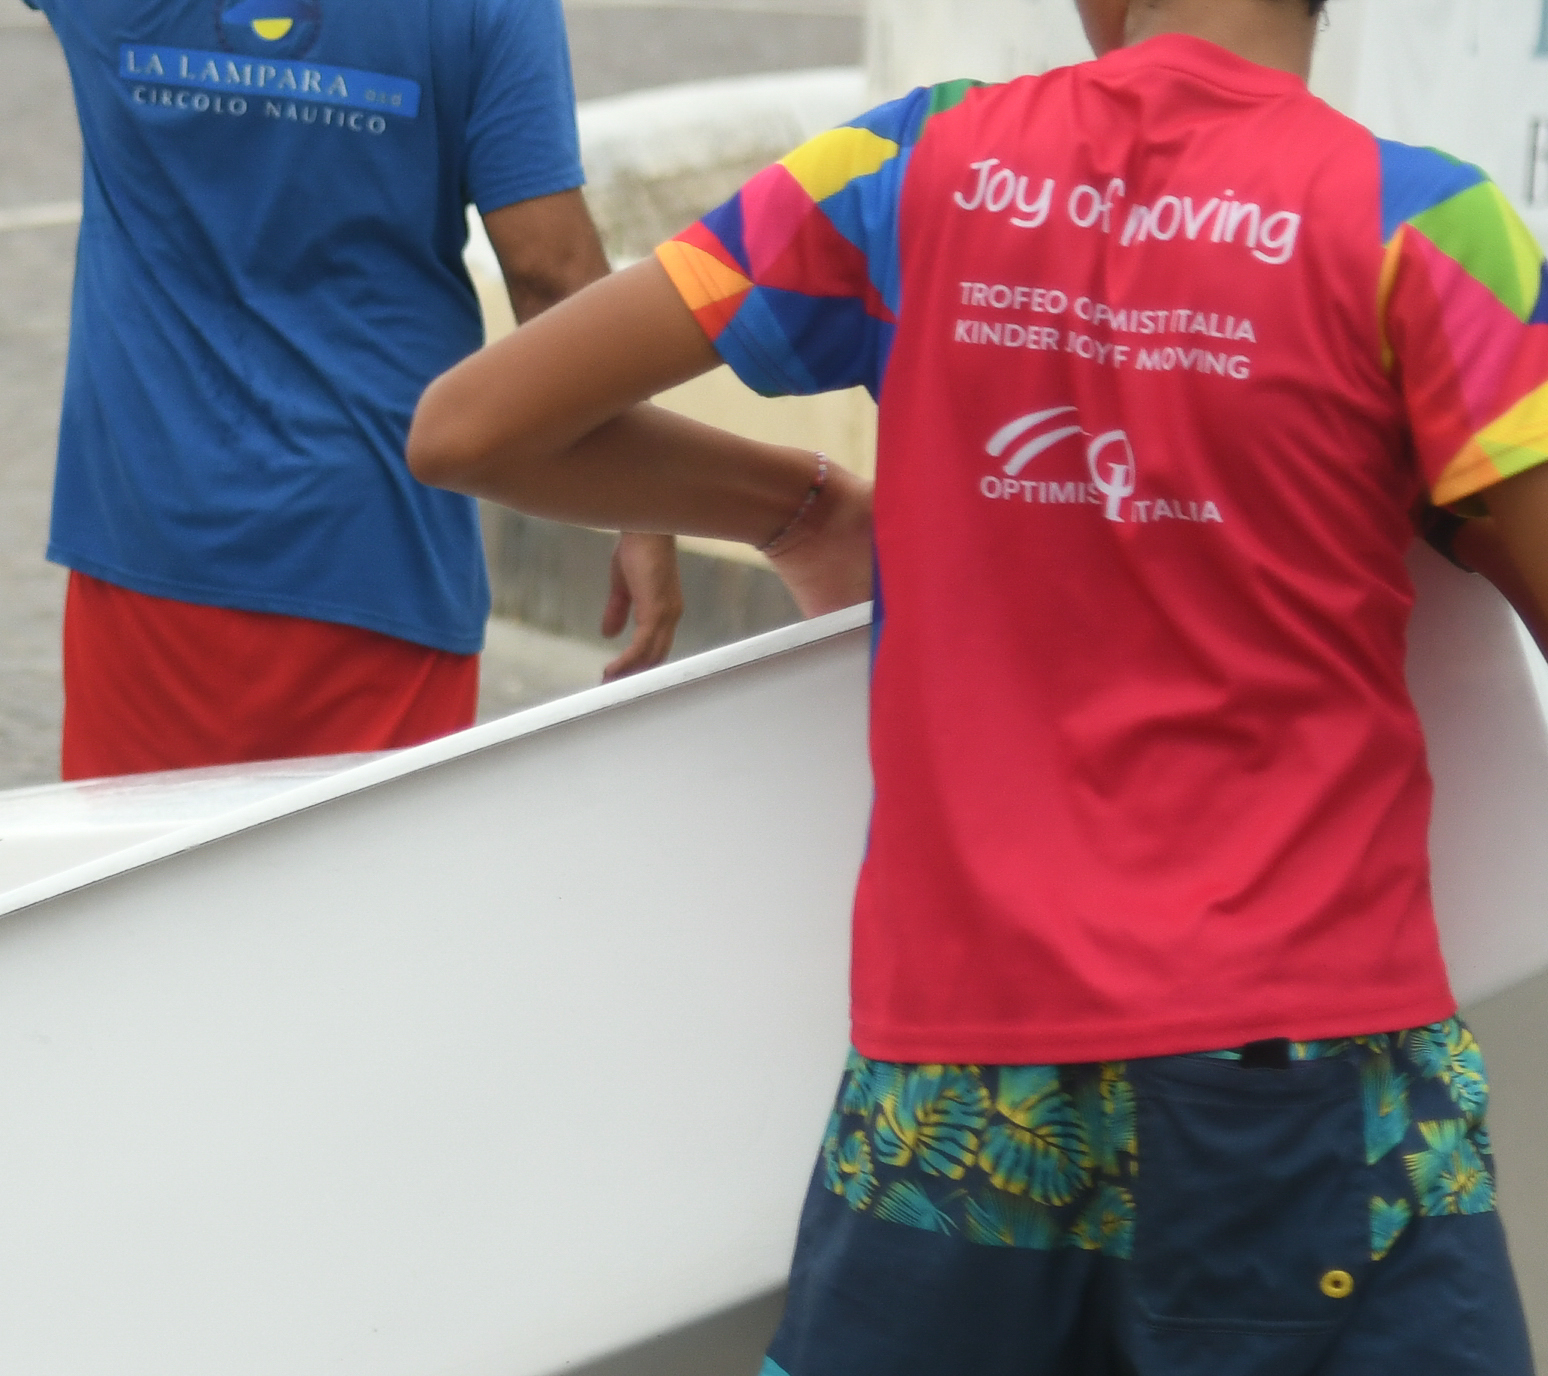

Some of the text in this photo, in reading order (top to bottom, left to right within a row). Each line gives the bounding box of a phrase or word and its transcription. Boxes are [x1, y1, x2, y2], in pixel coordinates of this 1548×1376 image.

[127, 50, 165, 76] LA
[179, 54, 349, 99] LAMPARA
[132, 84, 387, 135] CIRCOLO NAUTICO
[954, 158, 1055, 228] Joy
[1068, 177, 1126, 233] of
[959, 280, 1068, 315] TROFEO
[1169, 308, 1257, 344] ITALIA
[954, 318, 1059, 351] KINDER
[1134, 346, 1251, 380] MOVING
[979, 475, 1224, 523] OPTIMIS ITALIA
